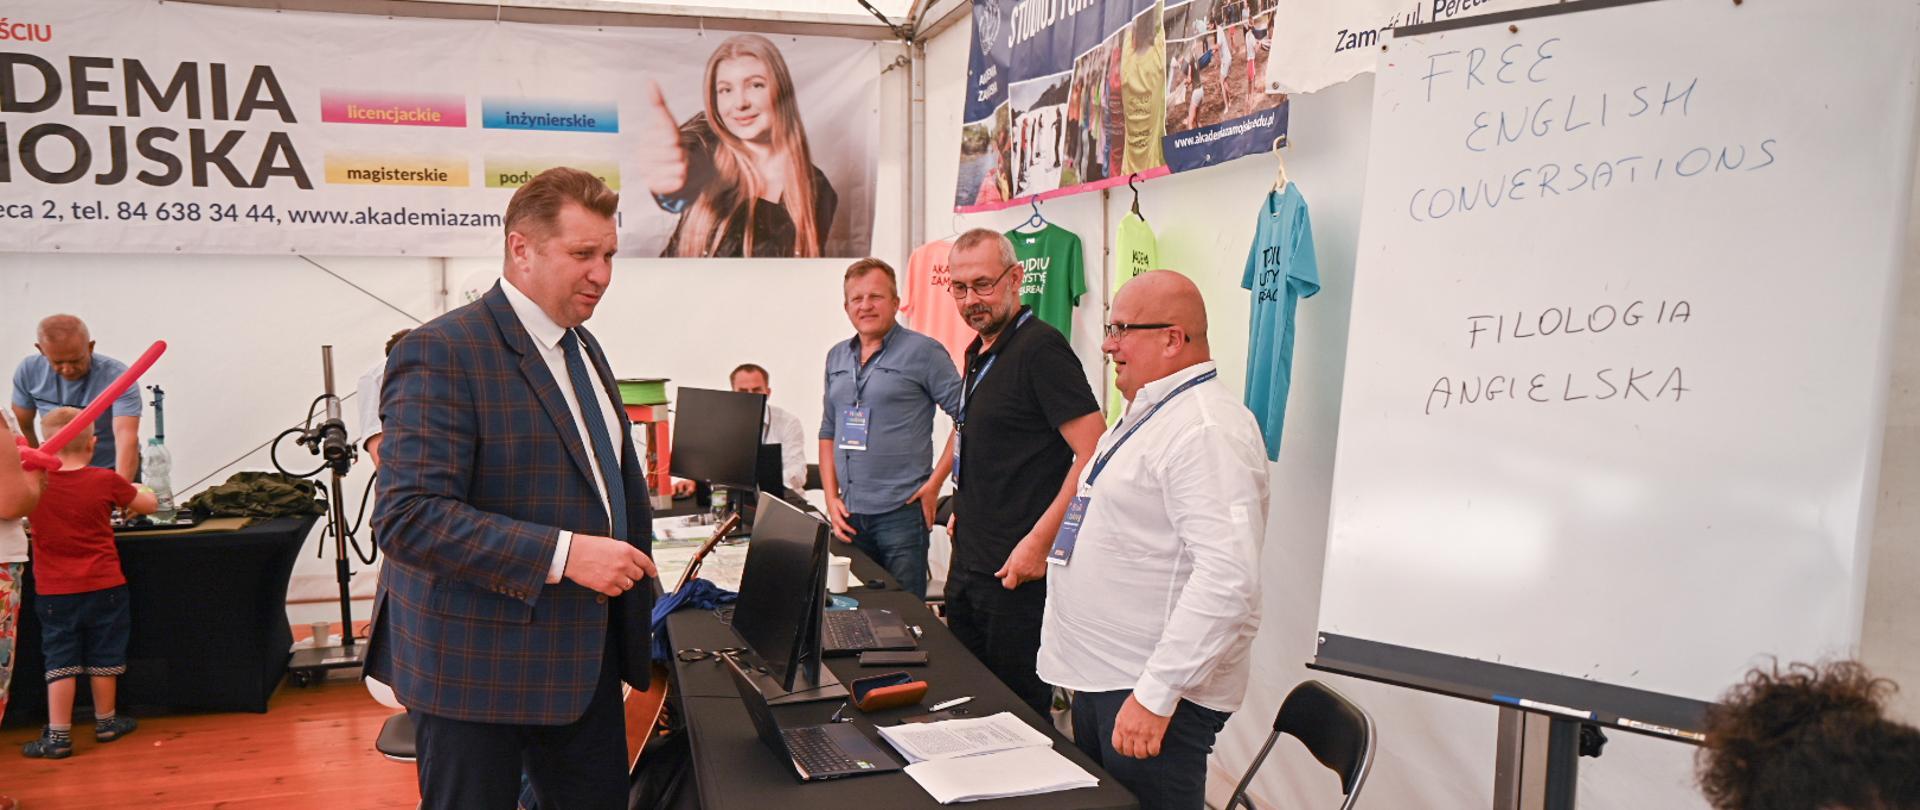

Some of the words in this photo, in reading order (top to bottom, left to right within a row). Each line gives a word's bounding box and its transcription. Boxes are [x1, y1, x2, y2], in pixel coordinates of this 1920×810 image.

[0, 18, 52, 42] ŚCIU
[0, 52, 298, 124] DEMIA
[1421, 38, 1561, 102] FREE
[347, 105, 441, 123] licencjackie
[505, 111, 596, 129] inżynierskie
[1465, 77, 1698, 152] ENGLISH
[0, 121, 314, 190] OJSKA
[347, 166, 448, 183] magisterskie
[1409, 139, 1777, 222] CONVERSATIONS
[41, 199, 63, 222] 2,
[71, 200, 109, 220] tel.
[117, 201, 148, 220] 84
[156, 202, 201, 221] 638
[209, 203, 239, 222] 34
[245, 204, 281, 226] 44,
[1468, 301, 1691, 349] FILOLOGIA
[1425, 366, 1691, 415] ANGIELSKA
